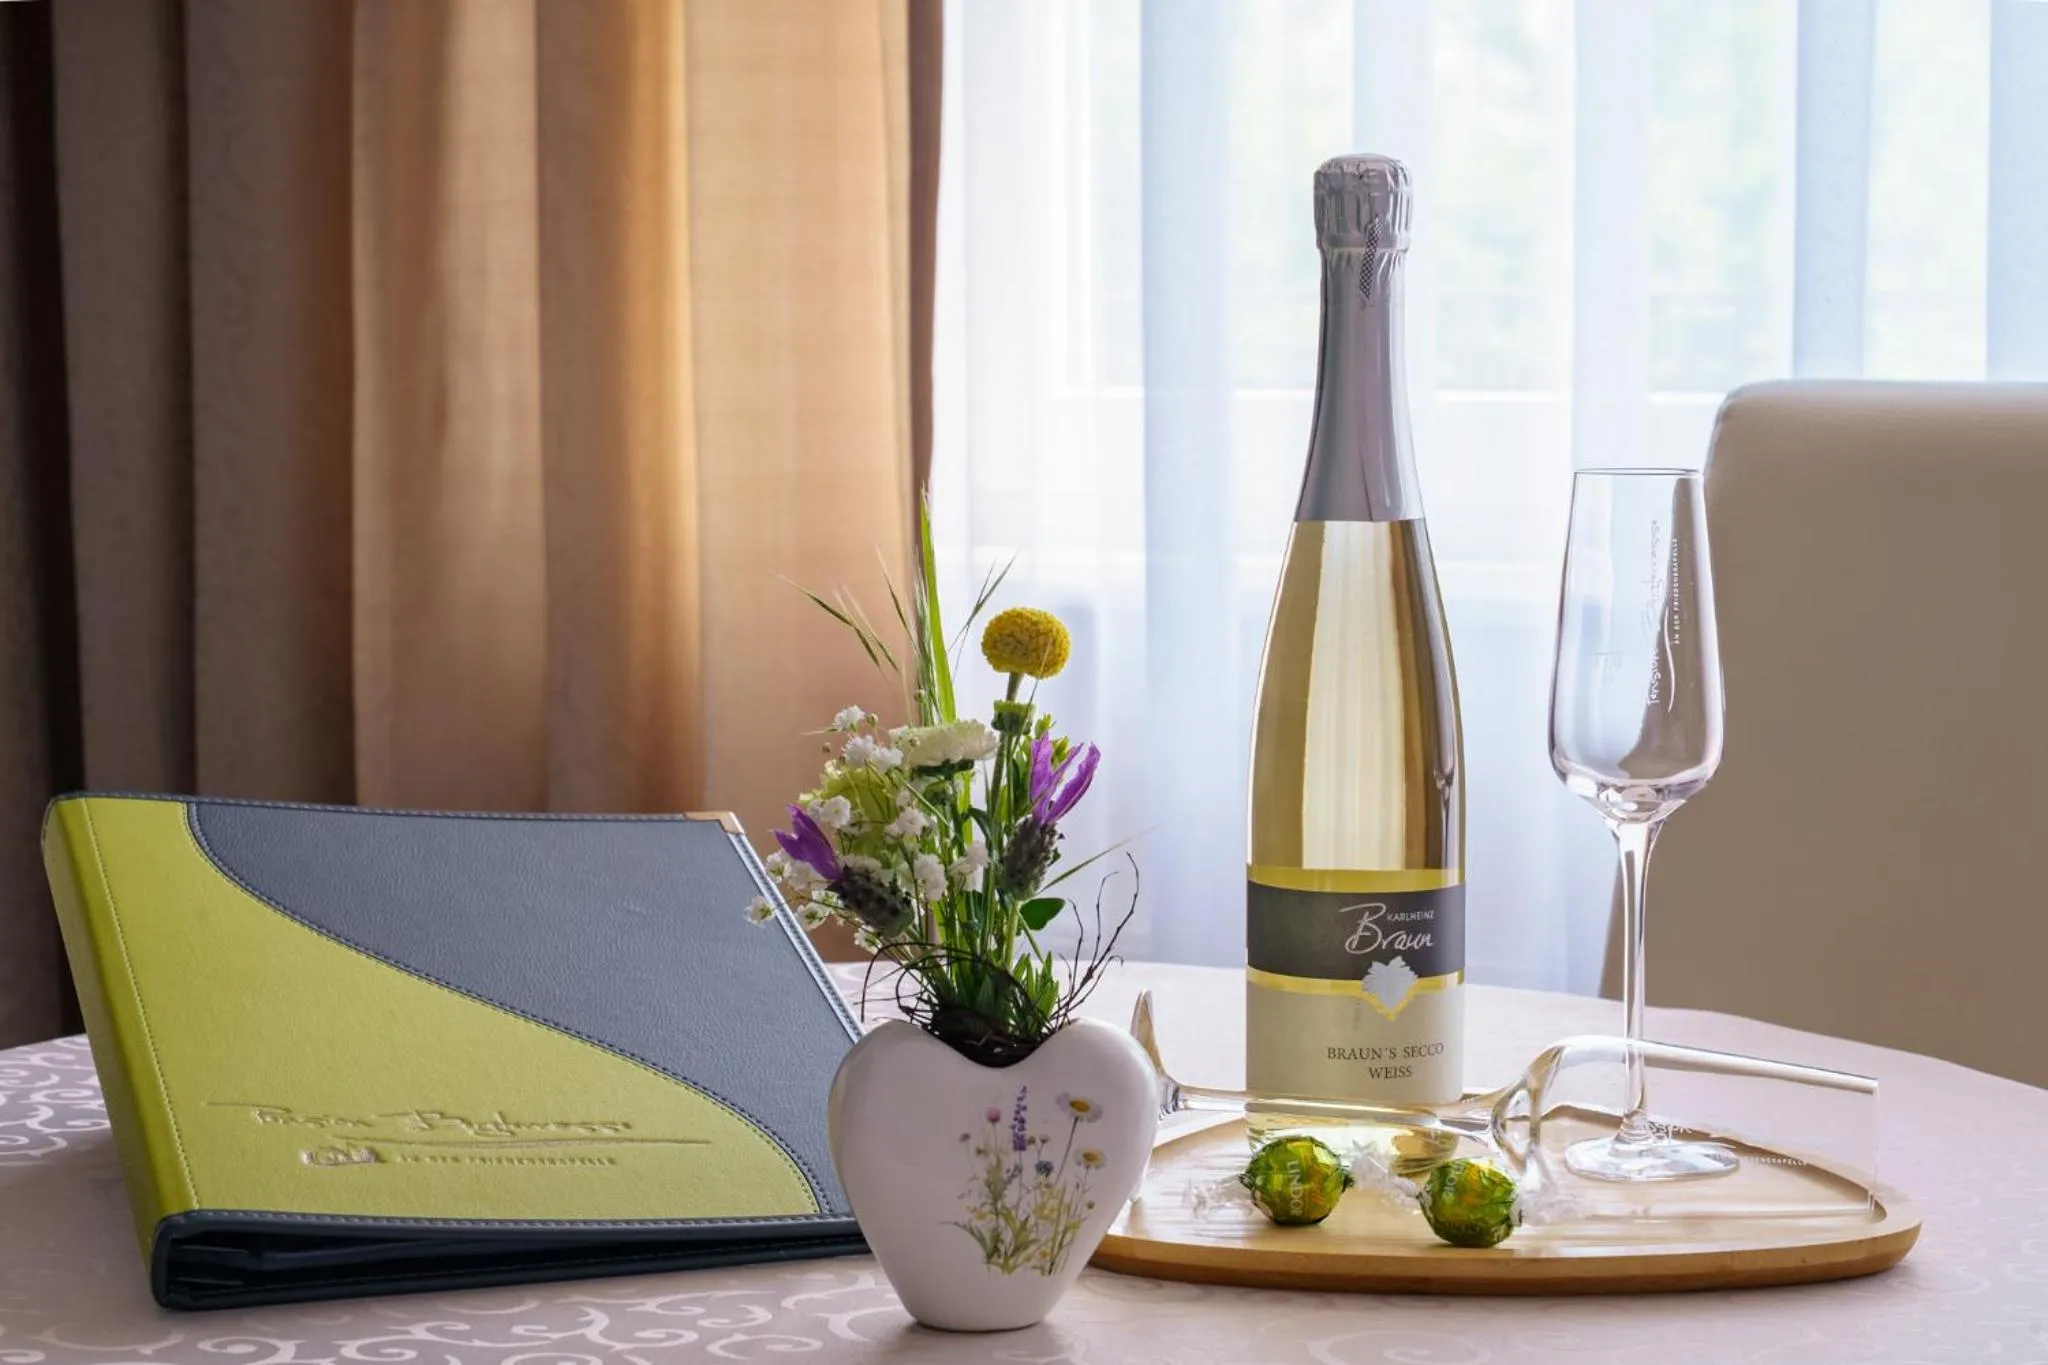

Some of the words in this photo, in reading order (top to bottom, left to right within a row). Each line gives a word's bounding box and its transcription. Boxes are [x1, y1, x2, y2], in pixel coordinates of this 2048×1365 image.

[1387, 910, 1435, 922] KARLHEINZ
[1338, 902, 1435, 955] Braun
[1403, 1042, 1445, 1058] SECCO
[1368, 1065, 1413, 1080] WEISS
[1287, 1160, 1304, 1217] LINDOR
